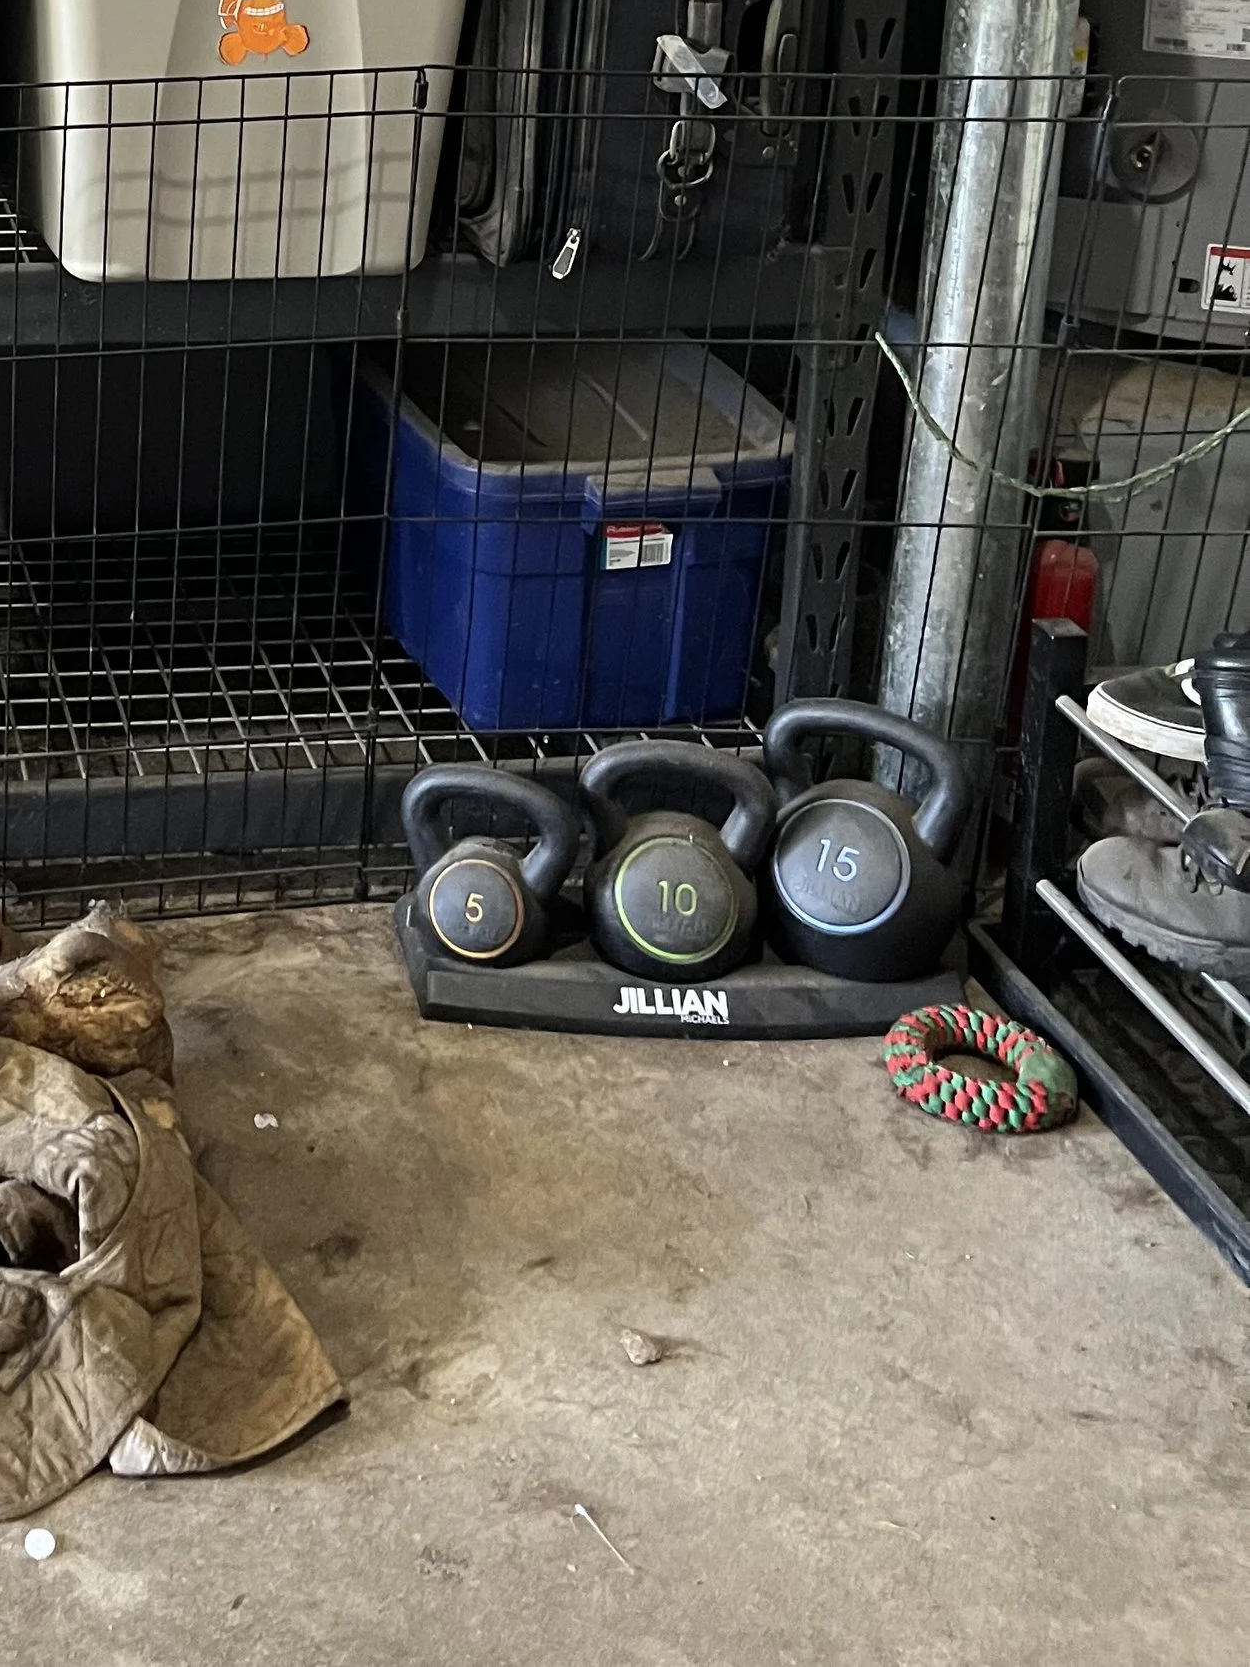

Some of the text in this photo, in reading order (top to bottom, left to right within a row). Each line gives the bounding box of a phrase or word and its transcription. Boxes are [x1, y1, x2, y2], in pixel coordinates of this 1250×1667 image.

[815, 837, 860, 883] 15
[465, 893, 484, 923] 5
[658, 880, 698, 917] 10
[612, 986, 729, 1017] JILLIAN
[680, 1014, 730, 1025] MICHAELS
